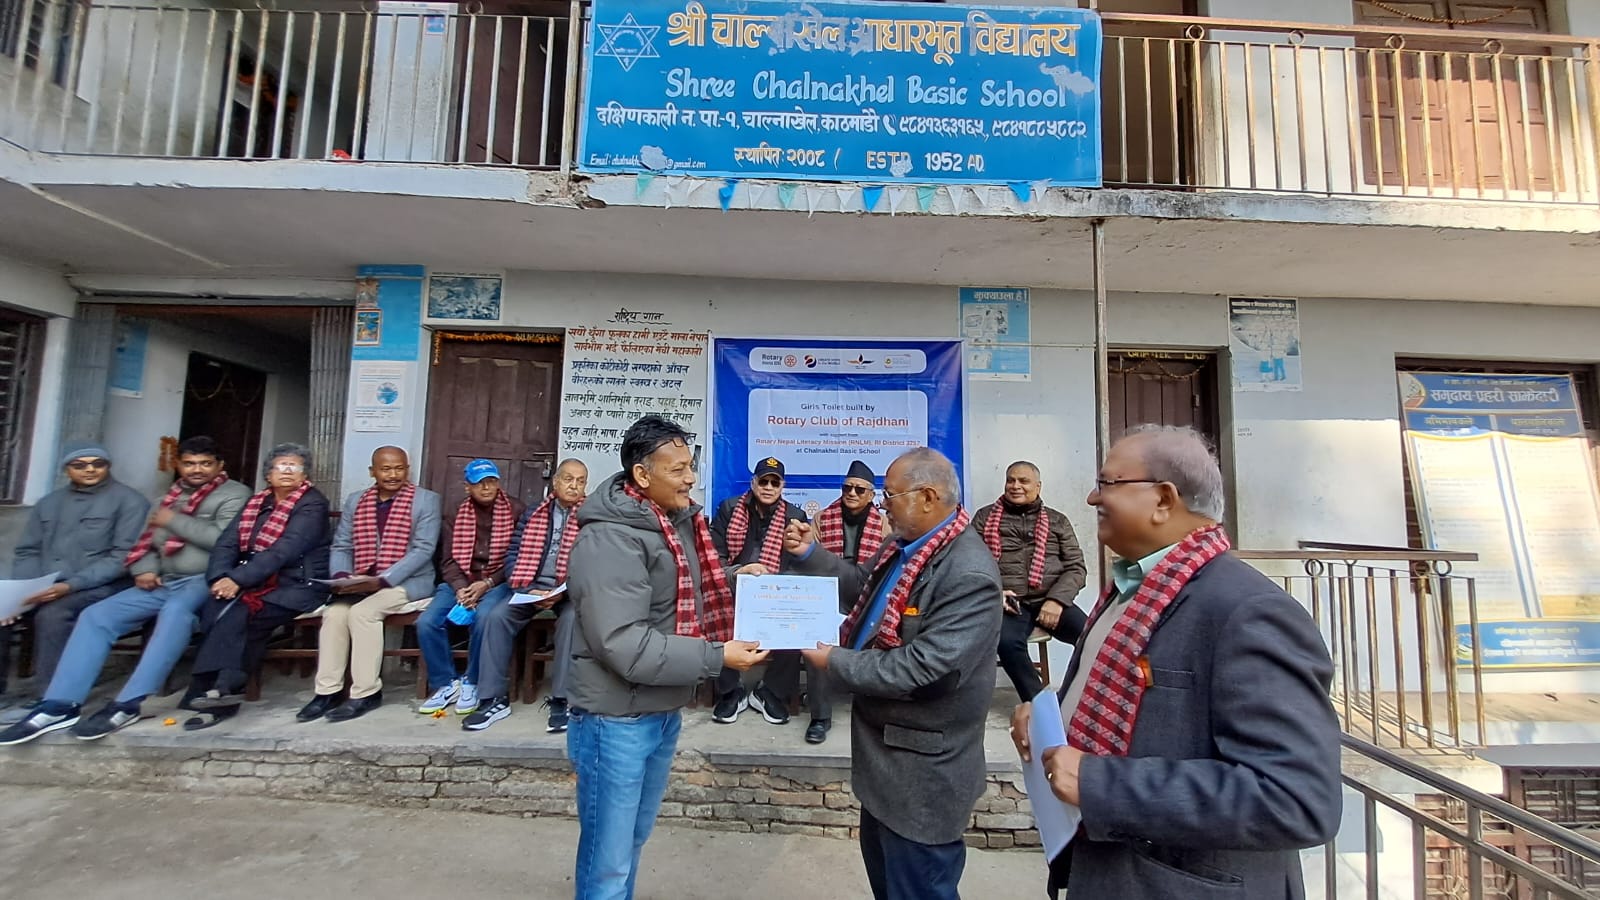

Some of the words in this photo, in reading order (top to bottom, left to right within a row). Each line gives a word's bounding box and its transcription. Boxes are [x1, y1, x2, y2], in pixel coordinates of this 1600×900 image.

[667, 1, 707, 47] श्री
[966, 10, 1082, 57] विद्यालय
[665, 67, 736, 98] Shree
[752, 70, 895, 107] Chalnakhel
[906, 75, 968, 106] Basic
[980, 79, 1066, 108] School
[596, 101, 679, 131] दक्षिणकाली
[924, 152, 963, 172] 1952
[643, 312, 664, 321] गान
[761, 353, 783, 362] Rotary
[800, 403, 820, 411] Girls
[822, 403, 844, 411] Toilet
[845, 403, 864, 411] built
[865, 404, 875, 412] by
[767, 415, 806, 428] Rotary
[810, 416, 838, 426] Club
[841, 416, 853, 426] of
[856, 416, 909, 428] Rajdhani
[756, 438, 776, 446] Rotary
[777, 439, 796, 447] Nepal
[796, 439, 821, 447] Literacy
